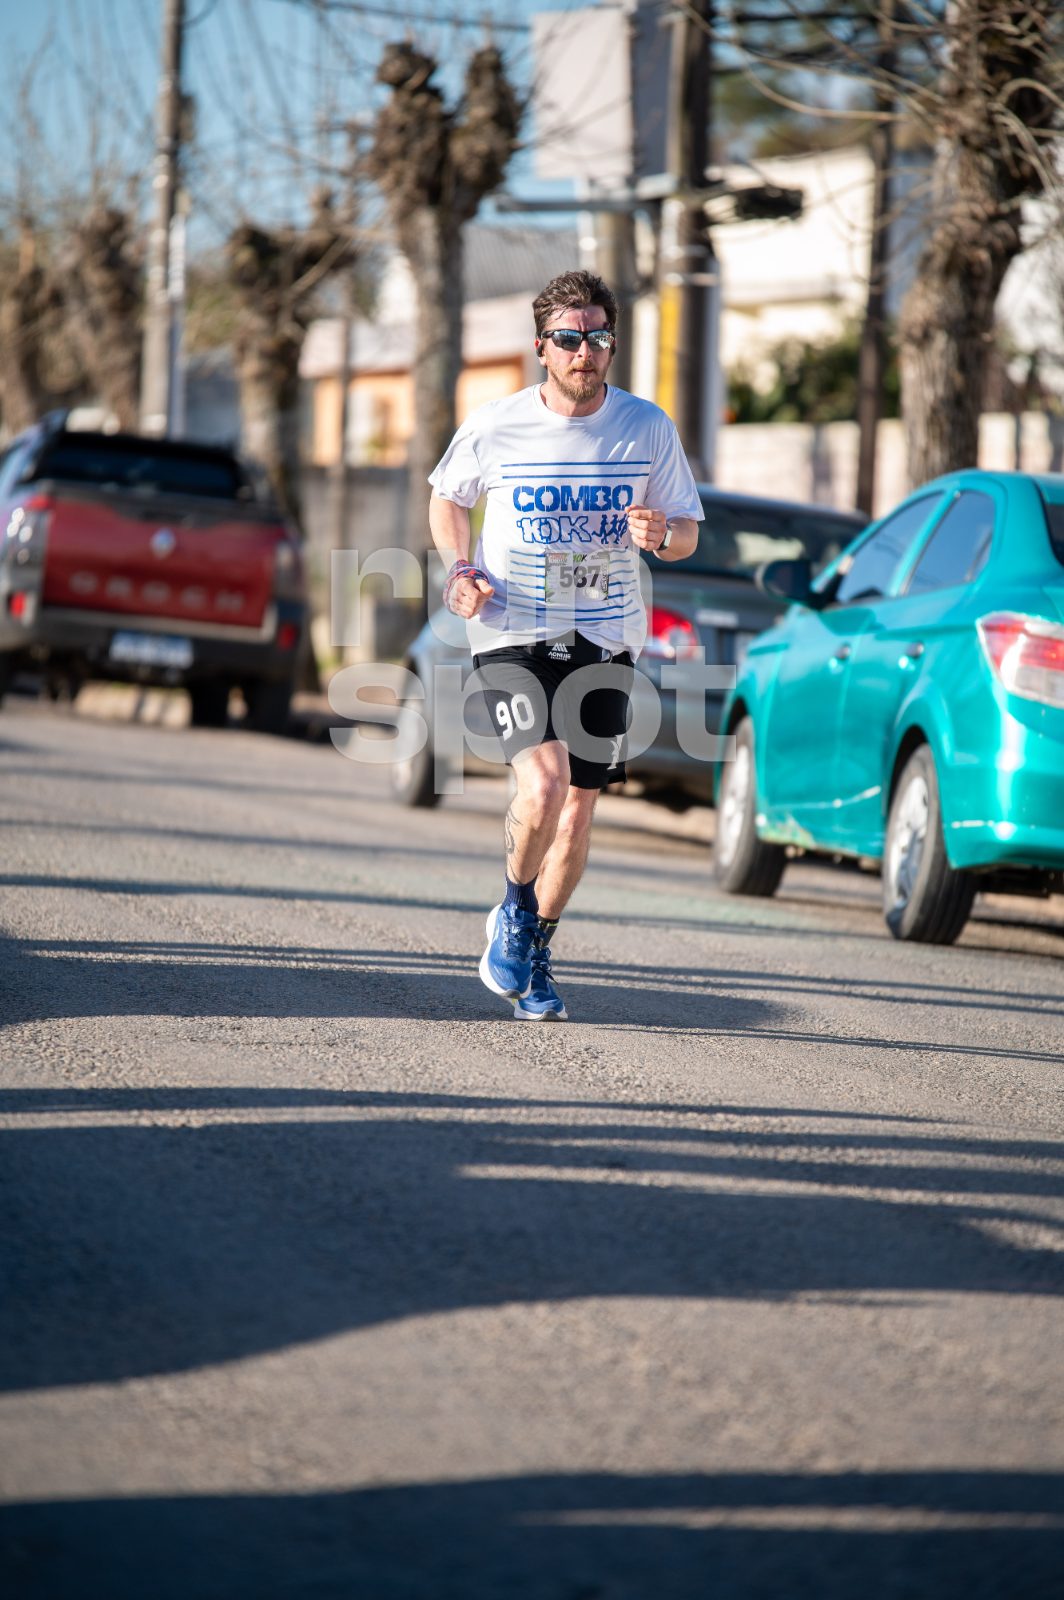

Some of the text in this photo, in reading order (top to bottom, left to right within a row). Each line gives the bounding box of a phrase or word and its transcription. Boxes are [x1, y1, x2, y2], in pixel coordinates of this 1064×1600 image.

[513, 485, 633, 512] COMBO
[516, 515, 592, 544] 10K
[560, 565, 601, 588] 587
[495, 693, 535, 742] 90
